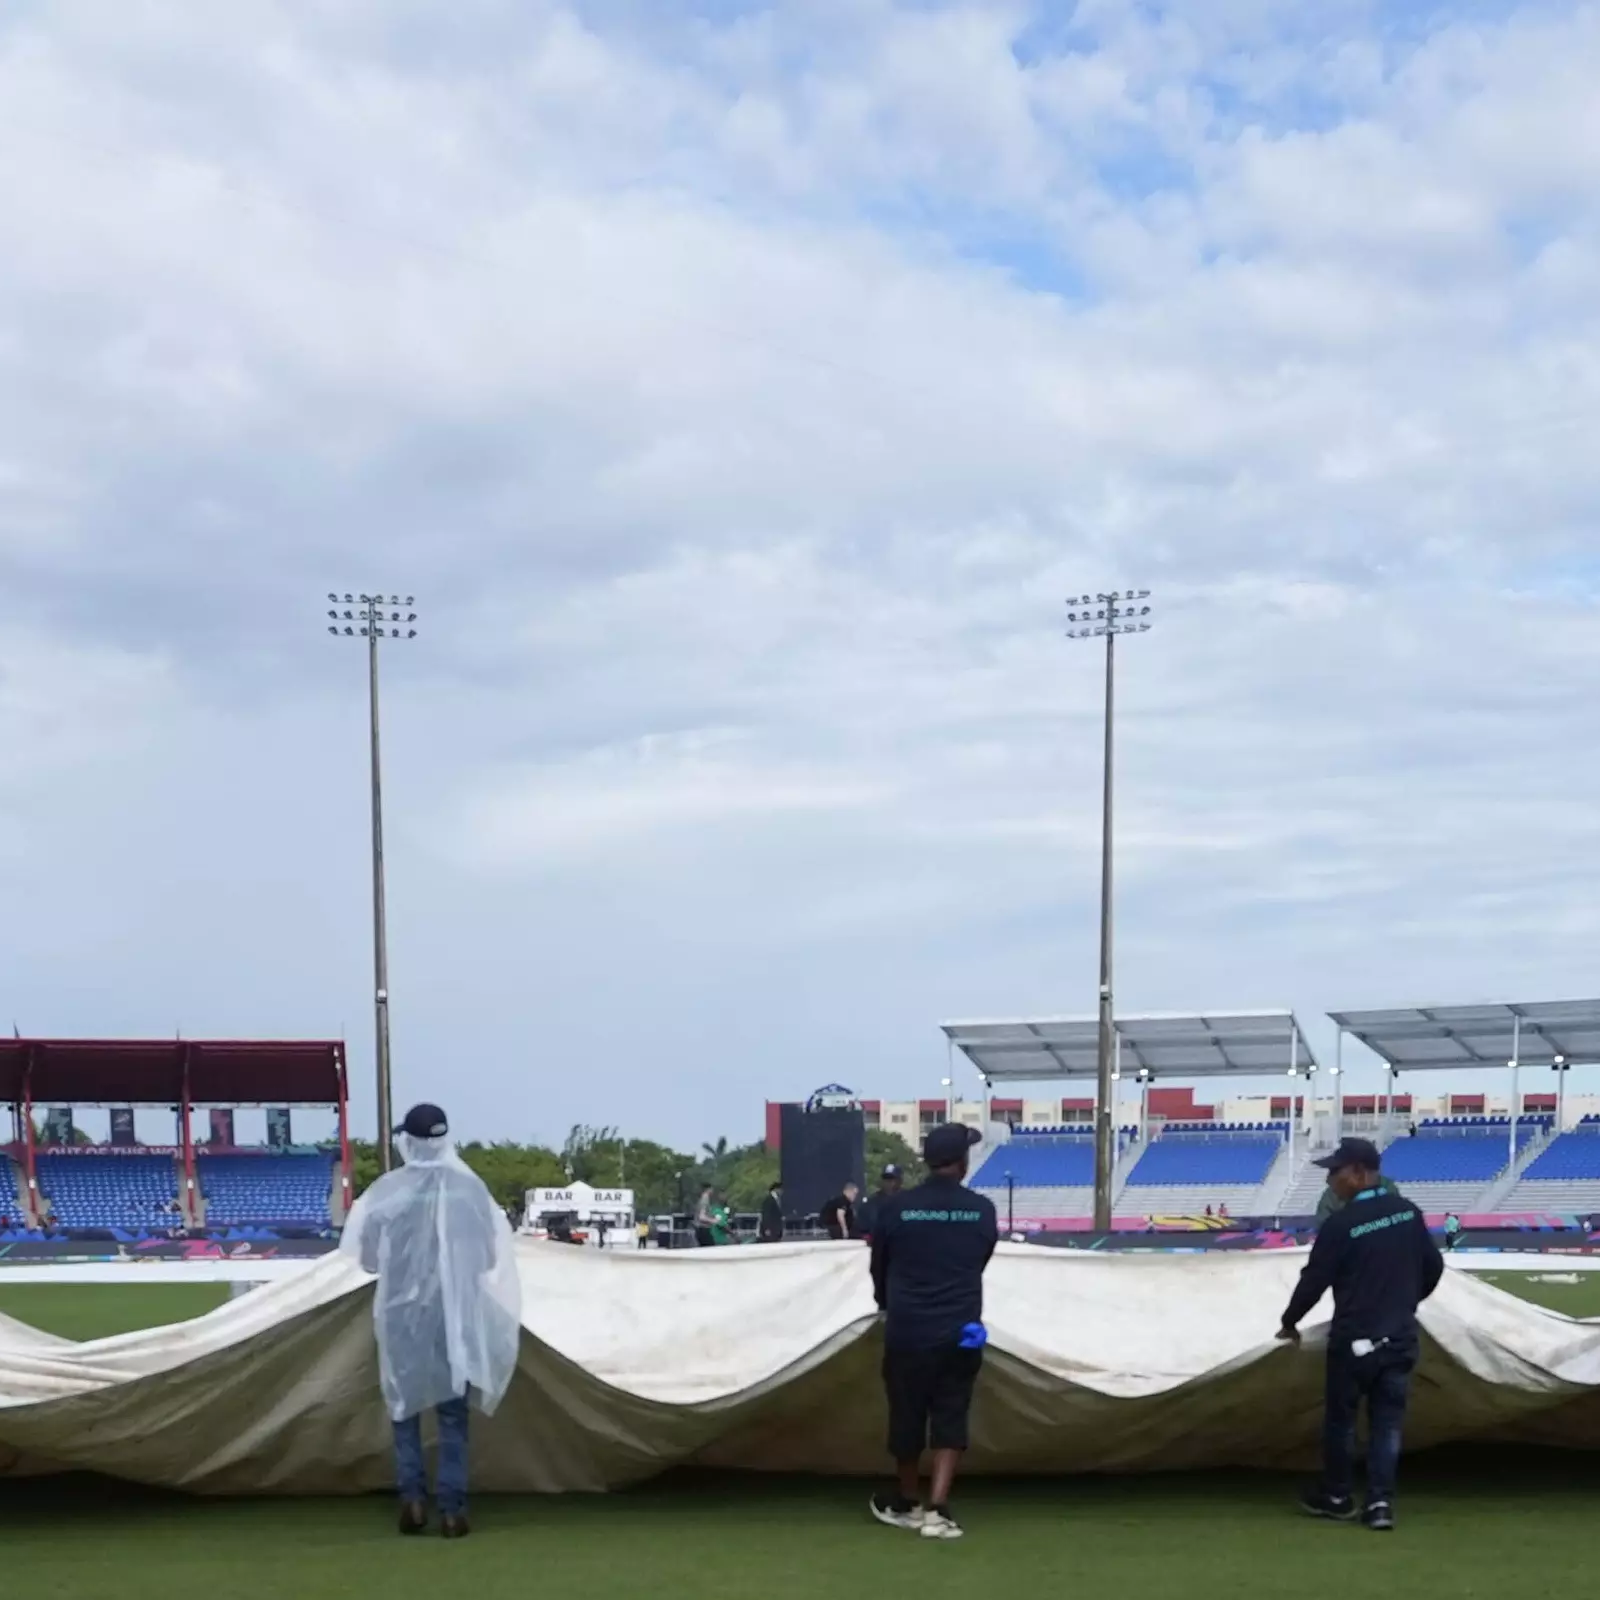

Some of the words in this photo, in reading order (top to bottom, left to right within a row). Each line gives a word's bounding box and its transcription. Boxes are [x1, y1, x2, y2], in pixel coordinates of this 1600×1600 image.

[544, 1191, 573, 1201] BAR
[594, 1192, 623, 1201] BAR
[900, 1210, 949, 1222] GROUND
[950, 1210, 981, 1222] STAFF
[1349, 1216, 1391, 1239] GROUND
